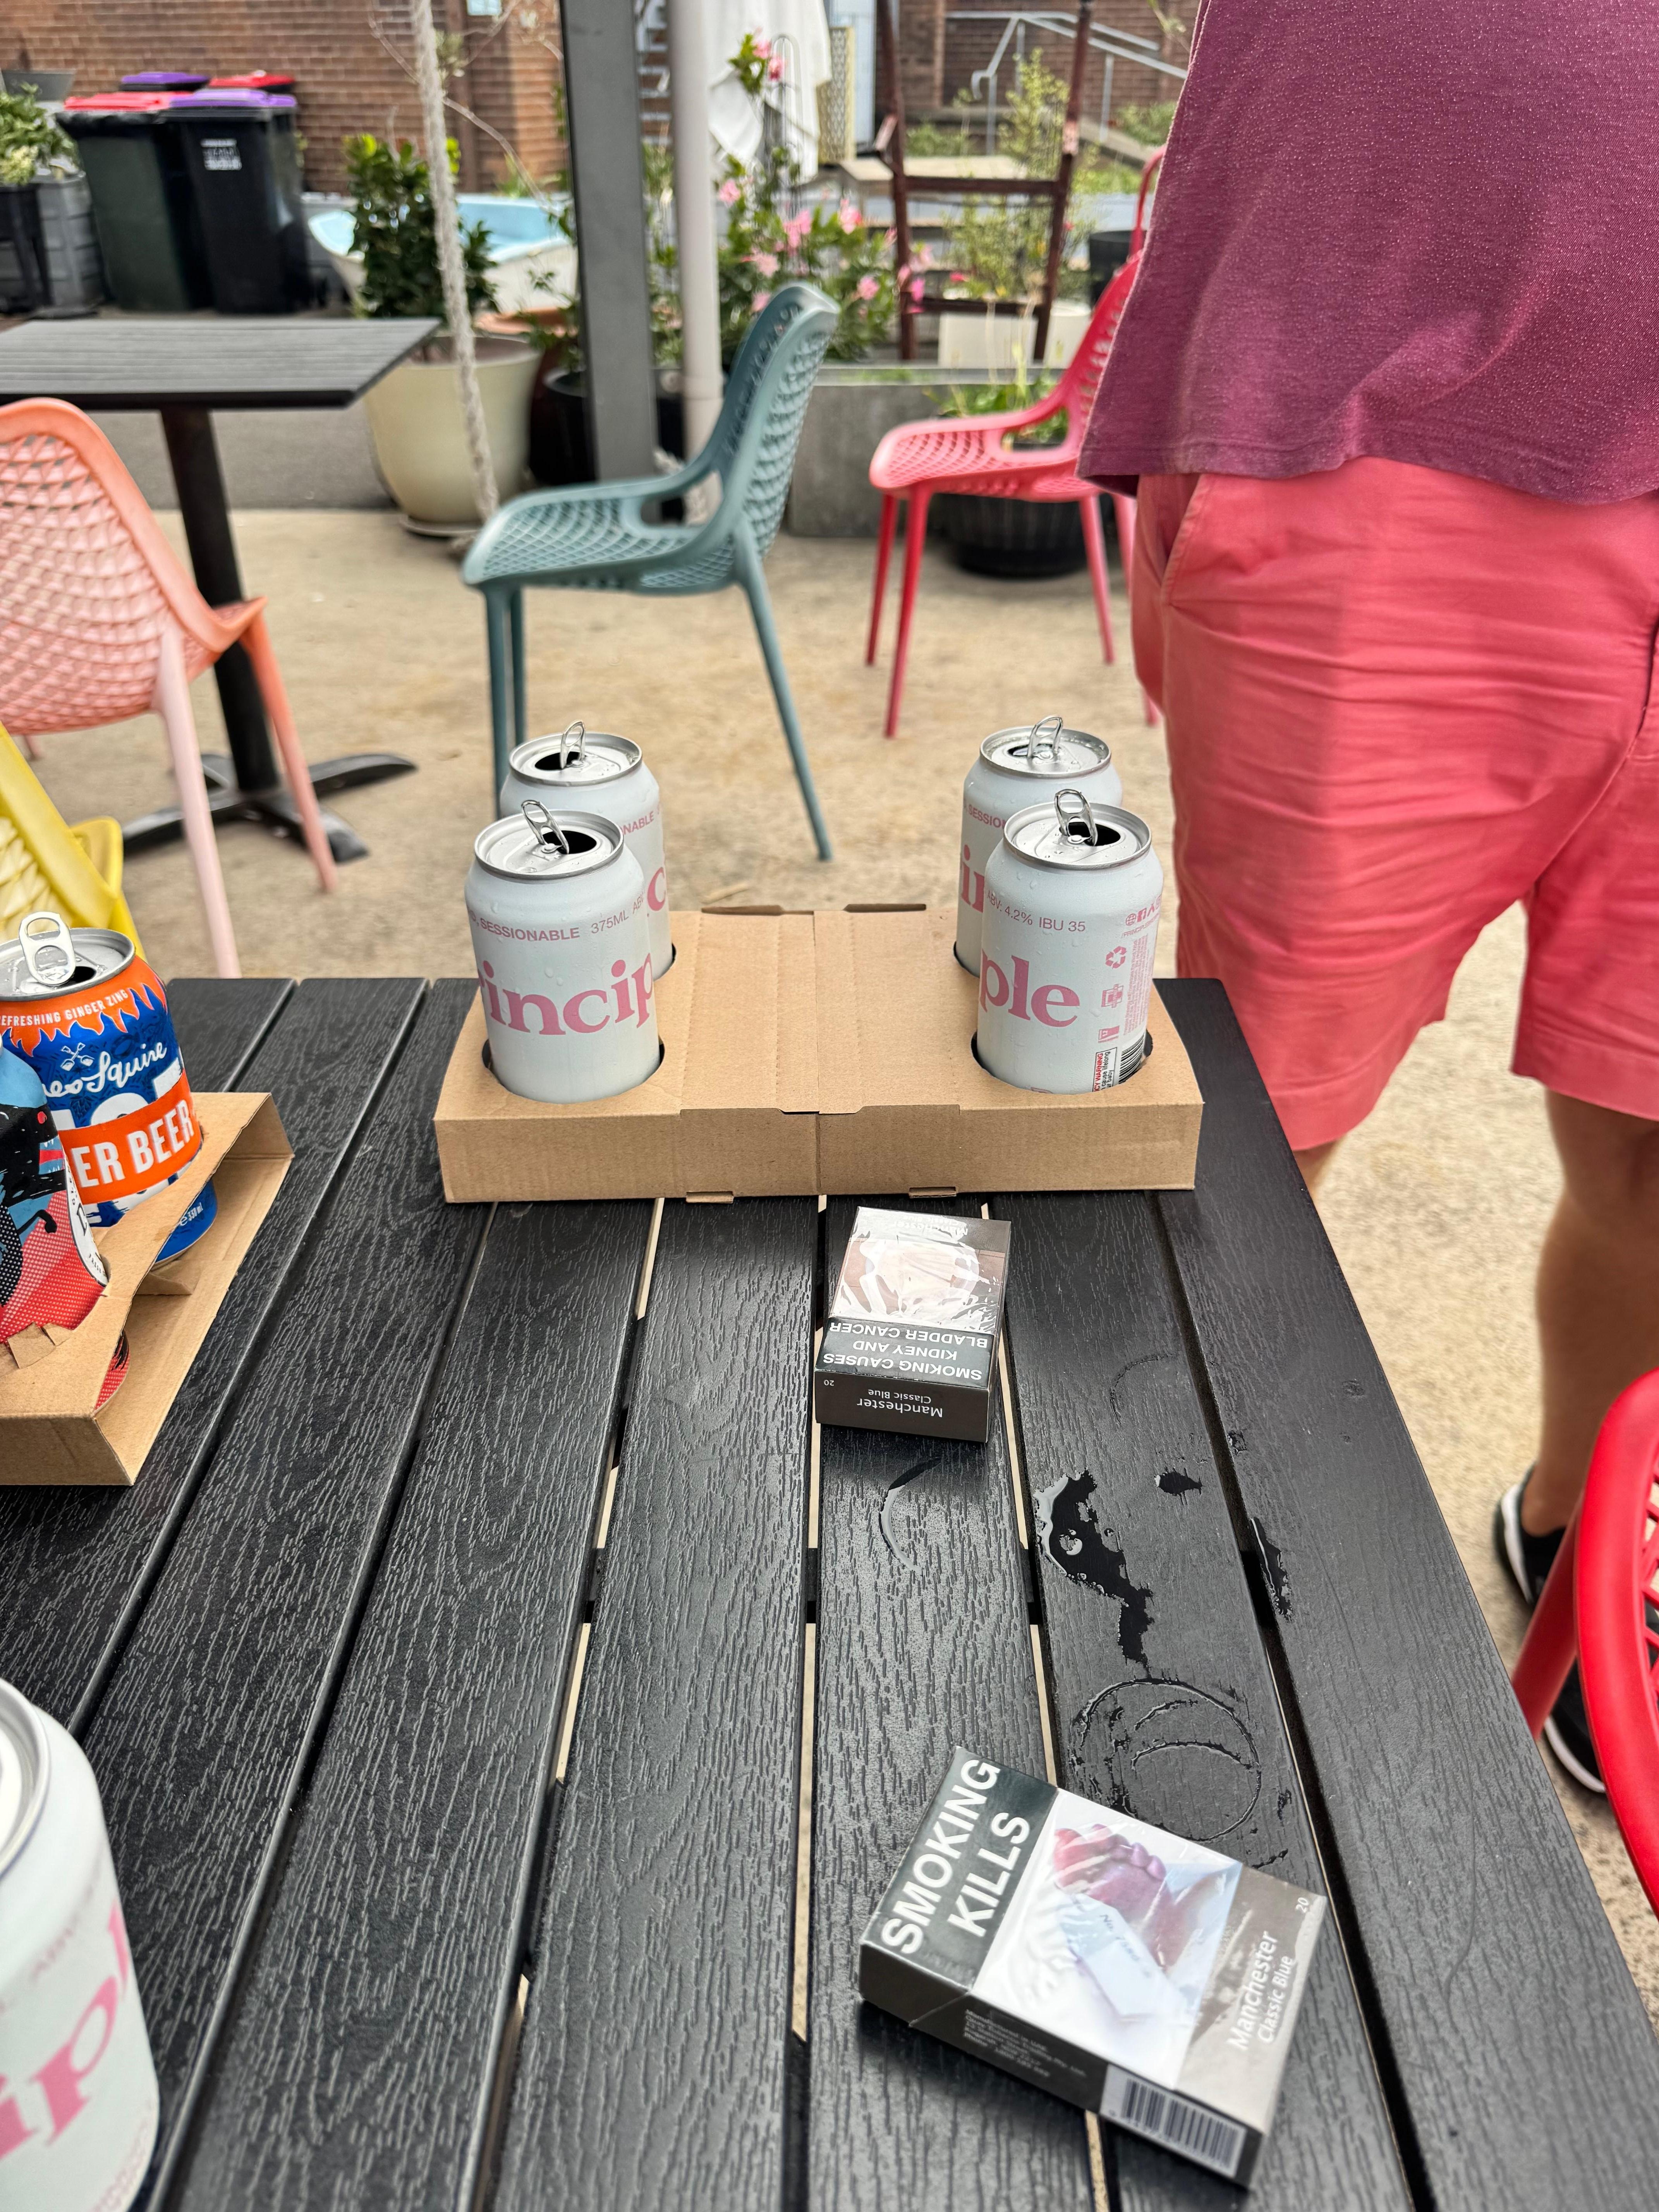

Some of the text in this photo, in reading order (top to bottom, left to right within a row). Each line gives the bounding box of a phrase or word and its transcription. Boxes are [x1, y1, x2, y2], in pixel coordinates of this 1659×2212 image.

[619, 811, 654, 835] NABLE
[480, 918, 580, 941] SESSIONABLE
[591, 910, 629, 934] 375ML
[1005, 906, 1032, 926] 4.2%
[1039, 917, 1064, 931] IBU
[1068, 921, 1085, 932] 35
[479, 953, 653, 1035] incip
[980, 948, 1080, 1027] ple
[0, 989, 129, 1027] EFRESHING GINGER ZING
[127, 1099, 194, 1174] BEER
[829, 1322, 988, 1349] BLADDER CANCER
[853, 1340, 957, 1361] KIDNEY AND
[823, 1353, 982, 1381] SMOKING CAUSES
[857, 1398, 943, 1418] Manchester
[868, 1389, 931, 1404] Classic Blue
[881, 1759, 1001, 1954] SMOKING
[947, 1812, 1030, 1937] KILLS
[1295, 1897, 1309, 1913] 20
[1226, 1930, 1278, 2051] Manchester
[1257, 1955, 1297, 2044] Classic Blue
